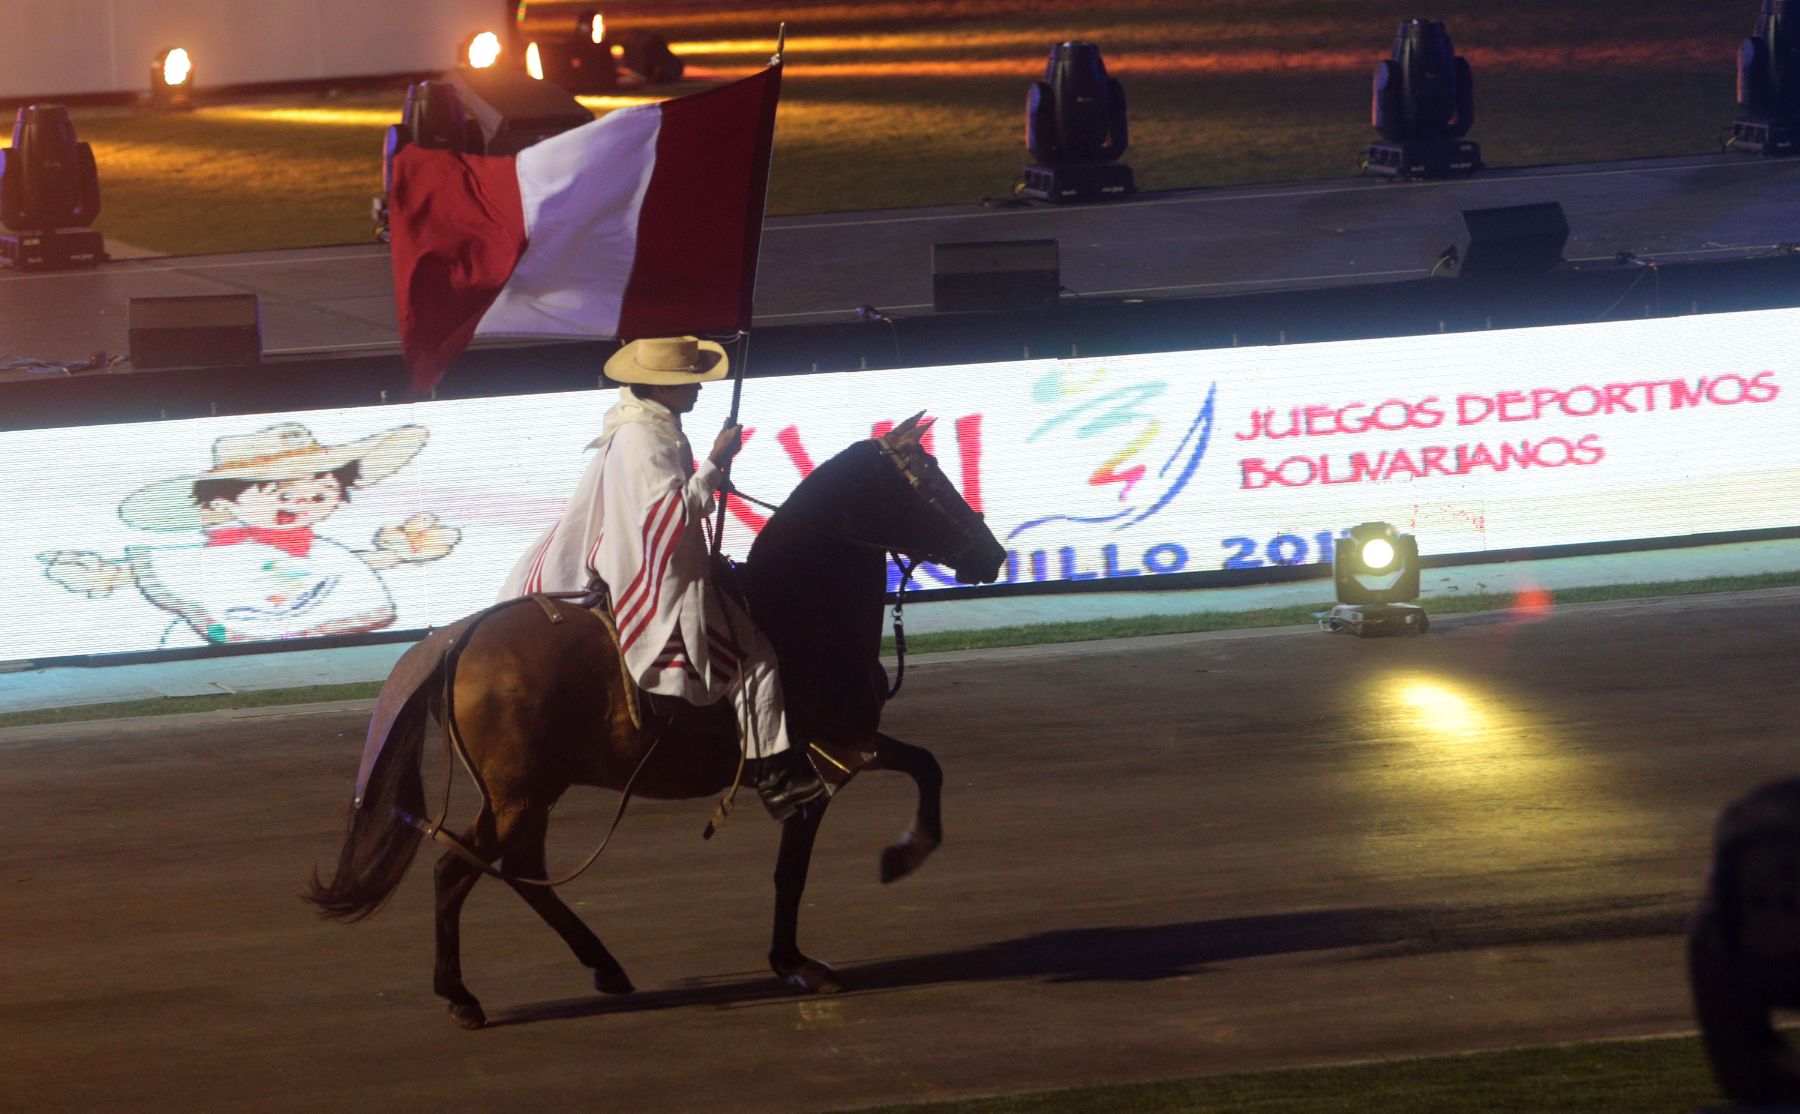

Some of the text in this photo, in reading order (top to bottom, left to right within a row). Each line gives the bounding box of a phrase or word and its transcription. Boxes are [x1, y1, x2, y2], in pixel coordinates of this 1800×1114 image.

[1234, 370, 1781, 441] JUEGOS DEPORTIVOS
[1237, 433, 1605, 490] BOLIVARIANOS
[1221, 529, 1351, 571] 201
